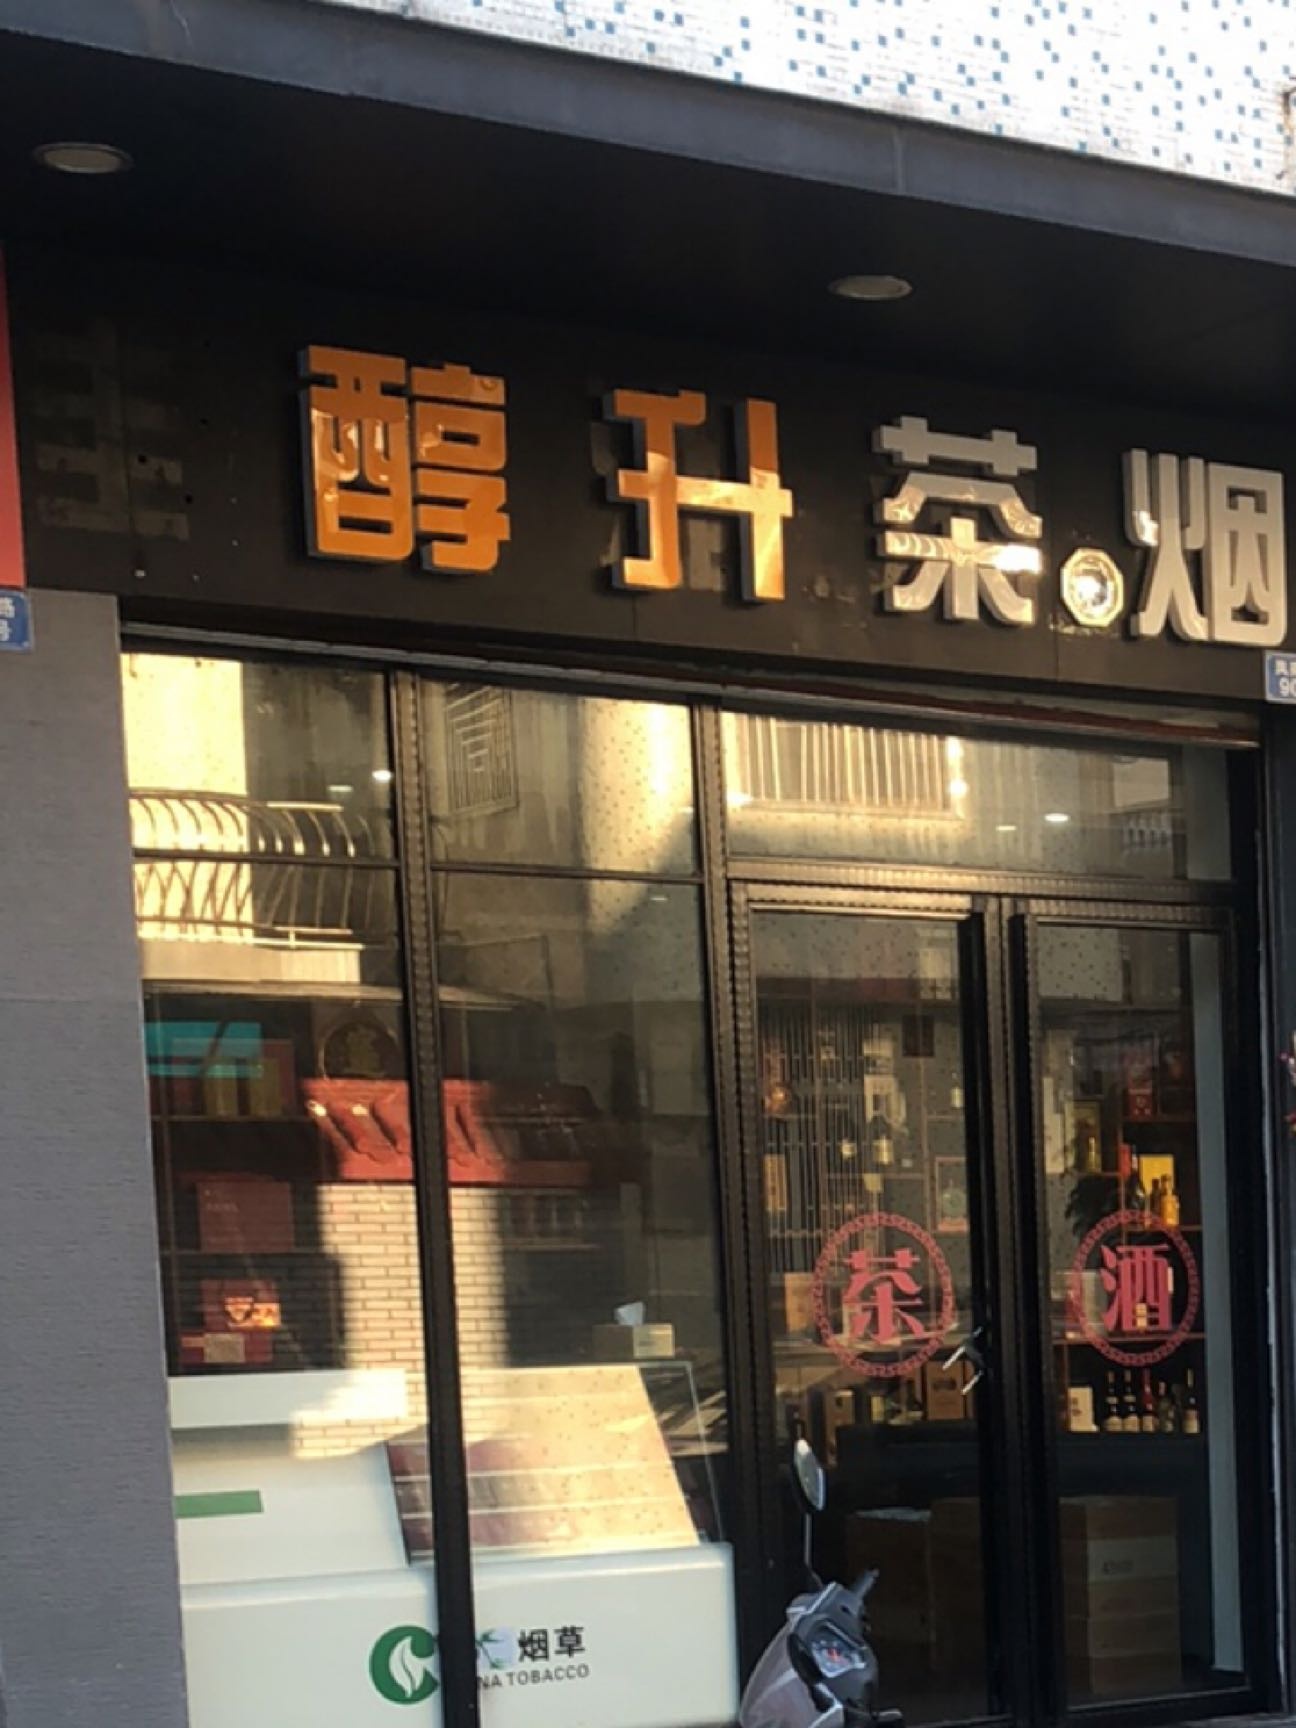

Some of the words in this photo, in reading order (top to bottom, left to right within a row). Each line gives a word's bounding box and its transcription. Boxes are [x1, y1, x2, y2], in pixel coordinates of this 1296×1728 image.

[843, 1248, 925, 1345] 茶
[1100, 1243, 1173, 1332] 酒
[506, 1663, 590, 1686] TOBACCO
